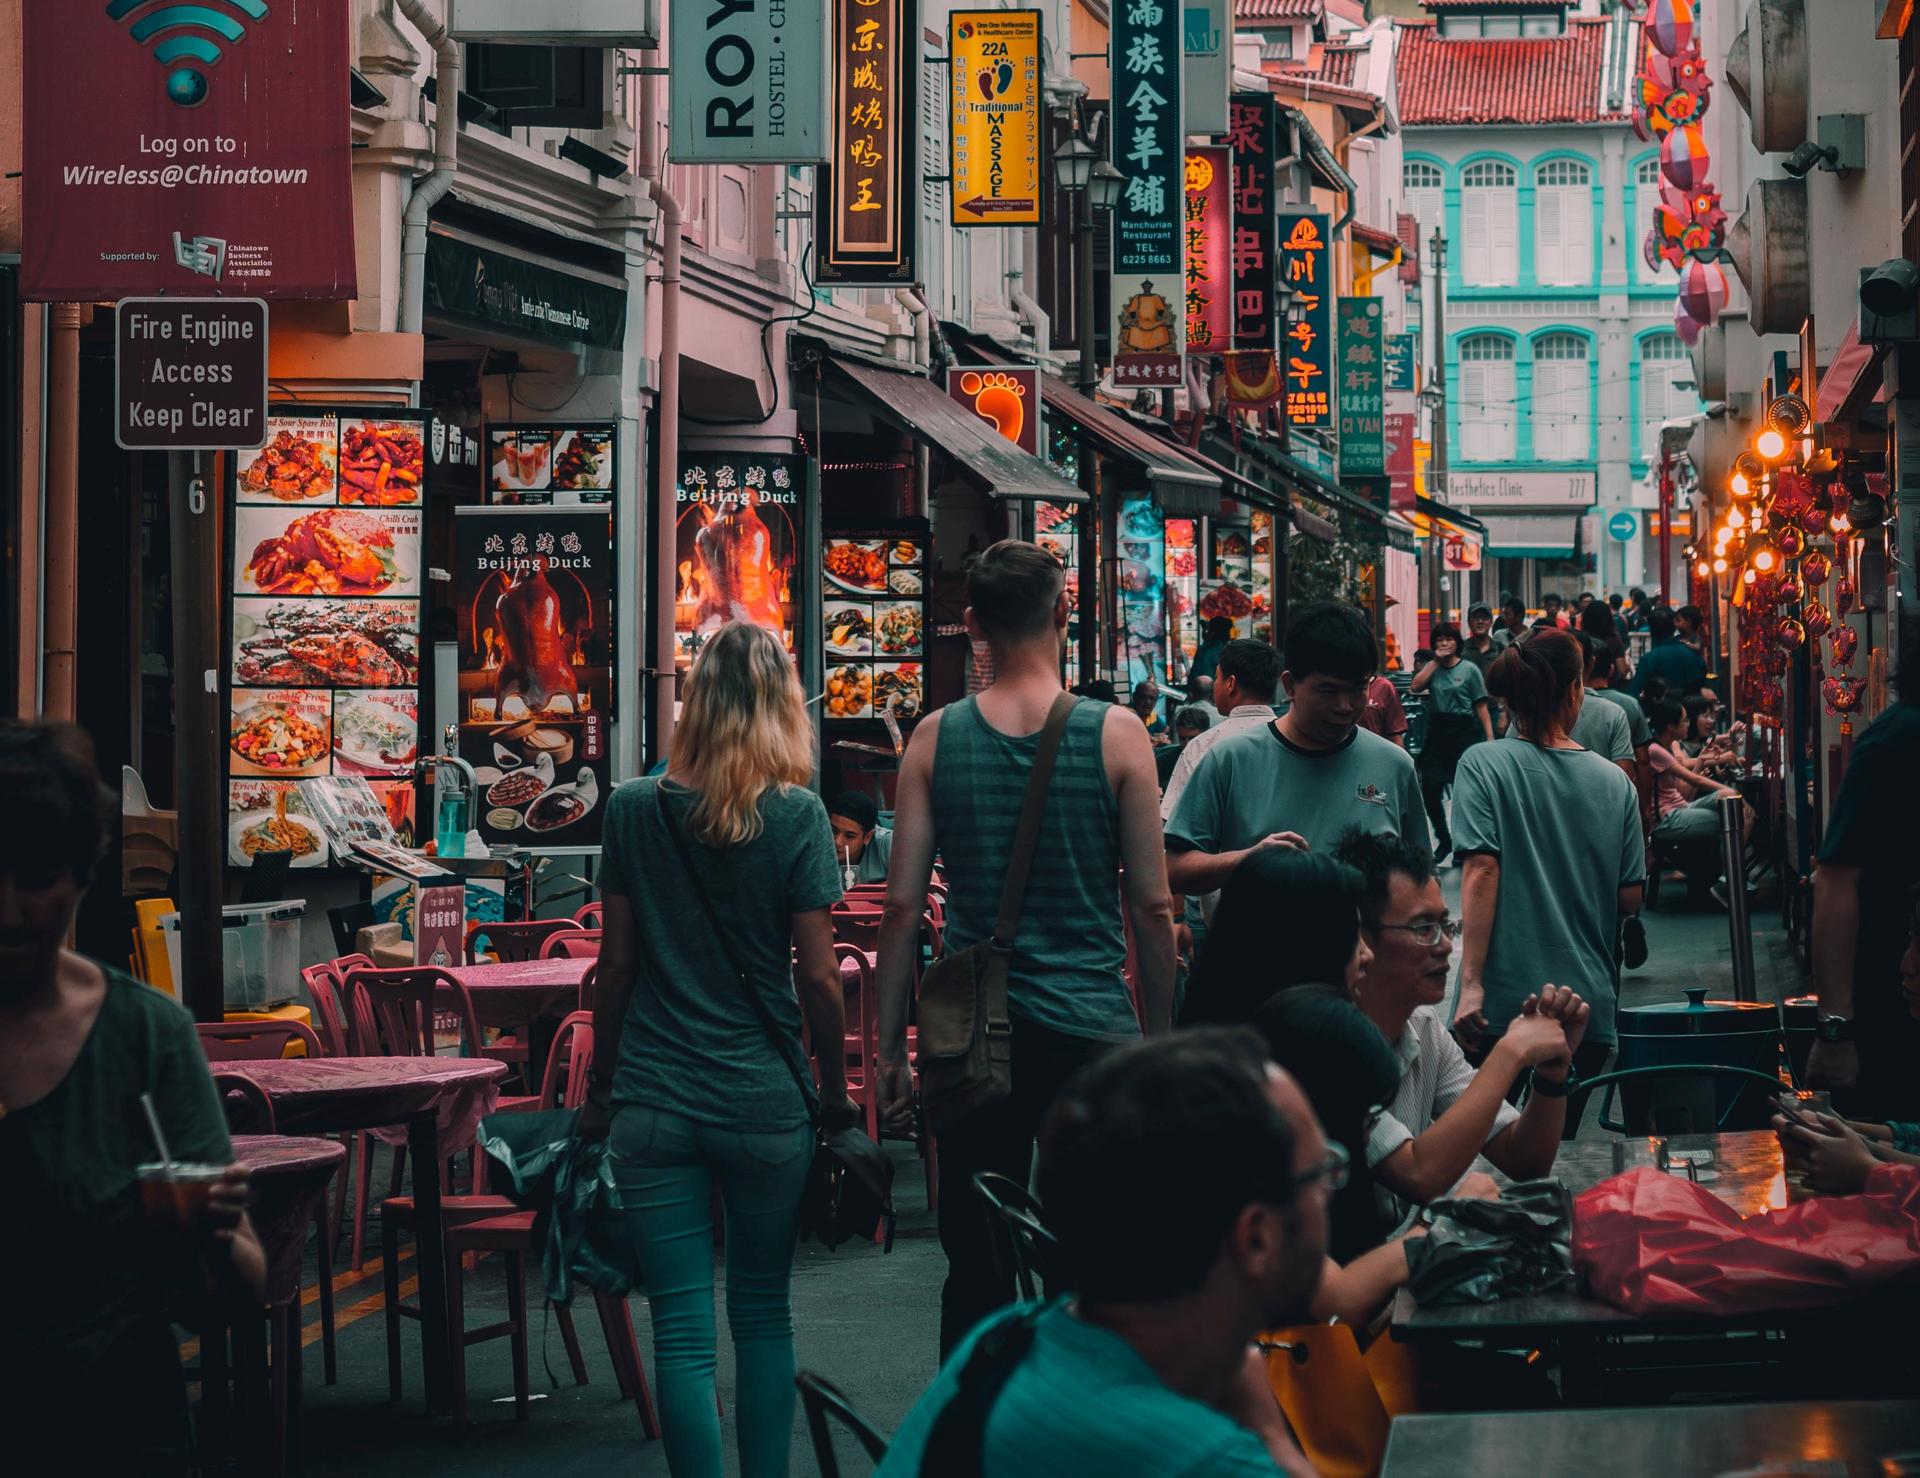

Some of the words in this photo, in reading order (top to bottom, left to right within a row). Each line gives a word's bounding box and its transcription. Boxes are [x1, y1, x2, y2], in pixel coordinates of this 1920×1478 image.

[982, 42, 1008, 56] 22A
[768, 51, 785, 137] HOSTEL
[969, 102, 1023, 112] Traditional
[140, 134, 177, 157] Log
[183, 138, 209, 153] on
[215, 135, 236, 153] to
[987, 112, 1005, 198] MASSAGE
[63, 164, 308, 188] Wireless@Chinatown
[1121, 221, 1172, 229] Manchurian
[1123, 231, 1171, 239] Restaurant
[1135, 243, 1159, 252] TEL:
[100, 252, 144, 262] Supported
[146, 252, 160, 262] by:
[1122, 255, 1146, 264] 6225
[130, 314, 173, 339] Fire
[181, 314, 254, 347] Engine
[151, 358, 233, 383] Access
[129, 402, 183, 433] Keep
[192, 402, 254, 427] Clear
[278, 418, 296, 427] Sour
[297, 418, 318, 428] Spare
[320, 418, 336, 428] Ribs
[1342, 417, 1353, 433] CI
[1357, 417, 1381, 433] YAN
[684, 464, 790, 488] 北京烤鸭
[1450, 477, 1495, 497] Aesthetics
[1499, 477, 1524, 497] Clinic
[677, 489, 750, 505] Beijing
[759, 489, 797, 504] Duck
[379, 514, 400, 523] Chilli
[402, 514, 419, 523] Crab
[484, 532, 582, 554] 北京烤鸭
[478, 556, 541, 571] Beijing
[548, 556, 592, 568] Duck
[400, 602, 417, 611] Crab
[233, 782, 258, 791] Fried
